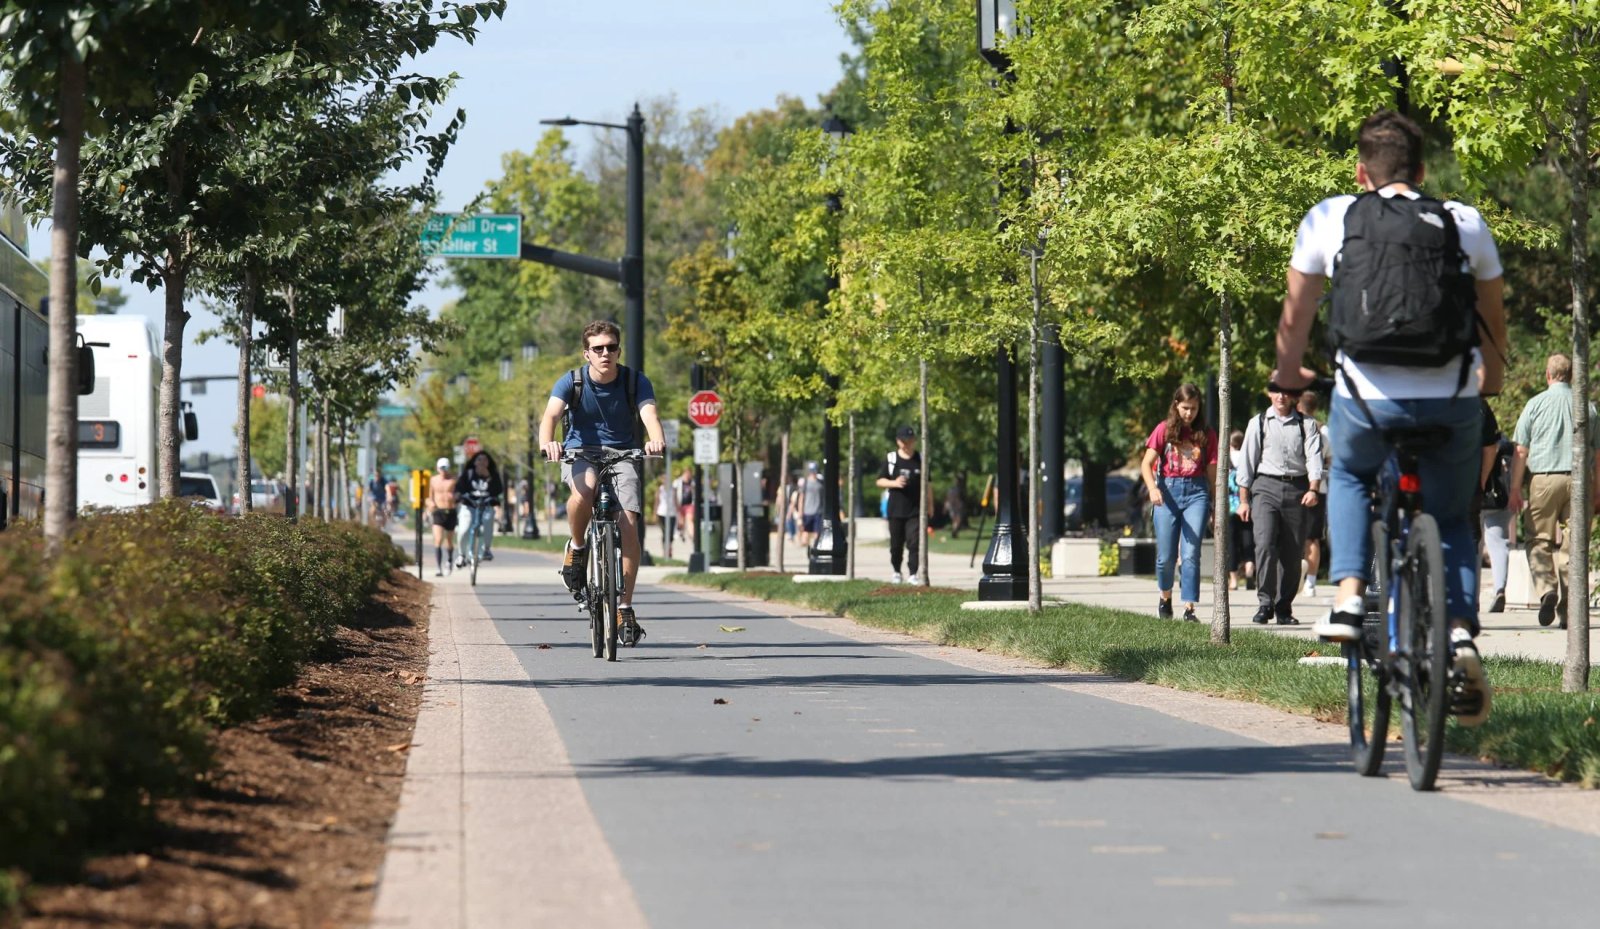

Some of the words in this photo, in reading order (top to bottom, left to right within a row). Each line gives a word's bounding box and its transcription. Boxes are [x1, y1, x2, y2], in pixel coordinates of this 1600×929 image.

[482, 219, 496, 233] Dr
[483, 238, 497, 253] St
[94, 423, 104, 441] 3
